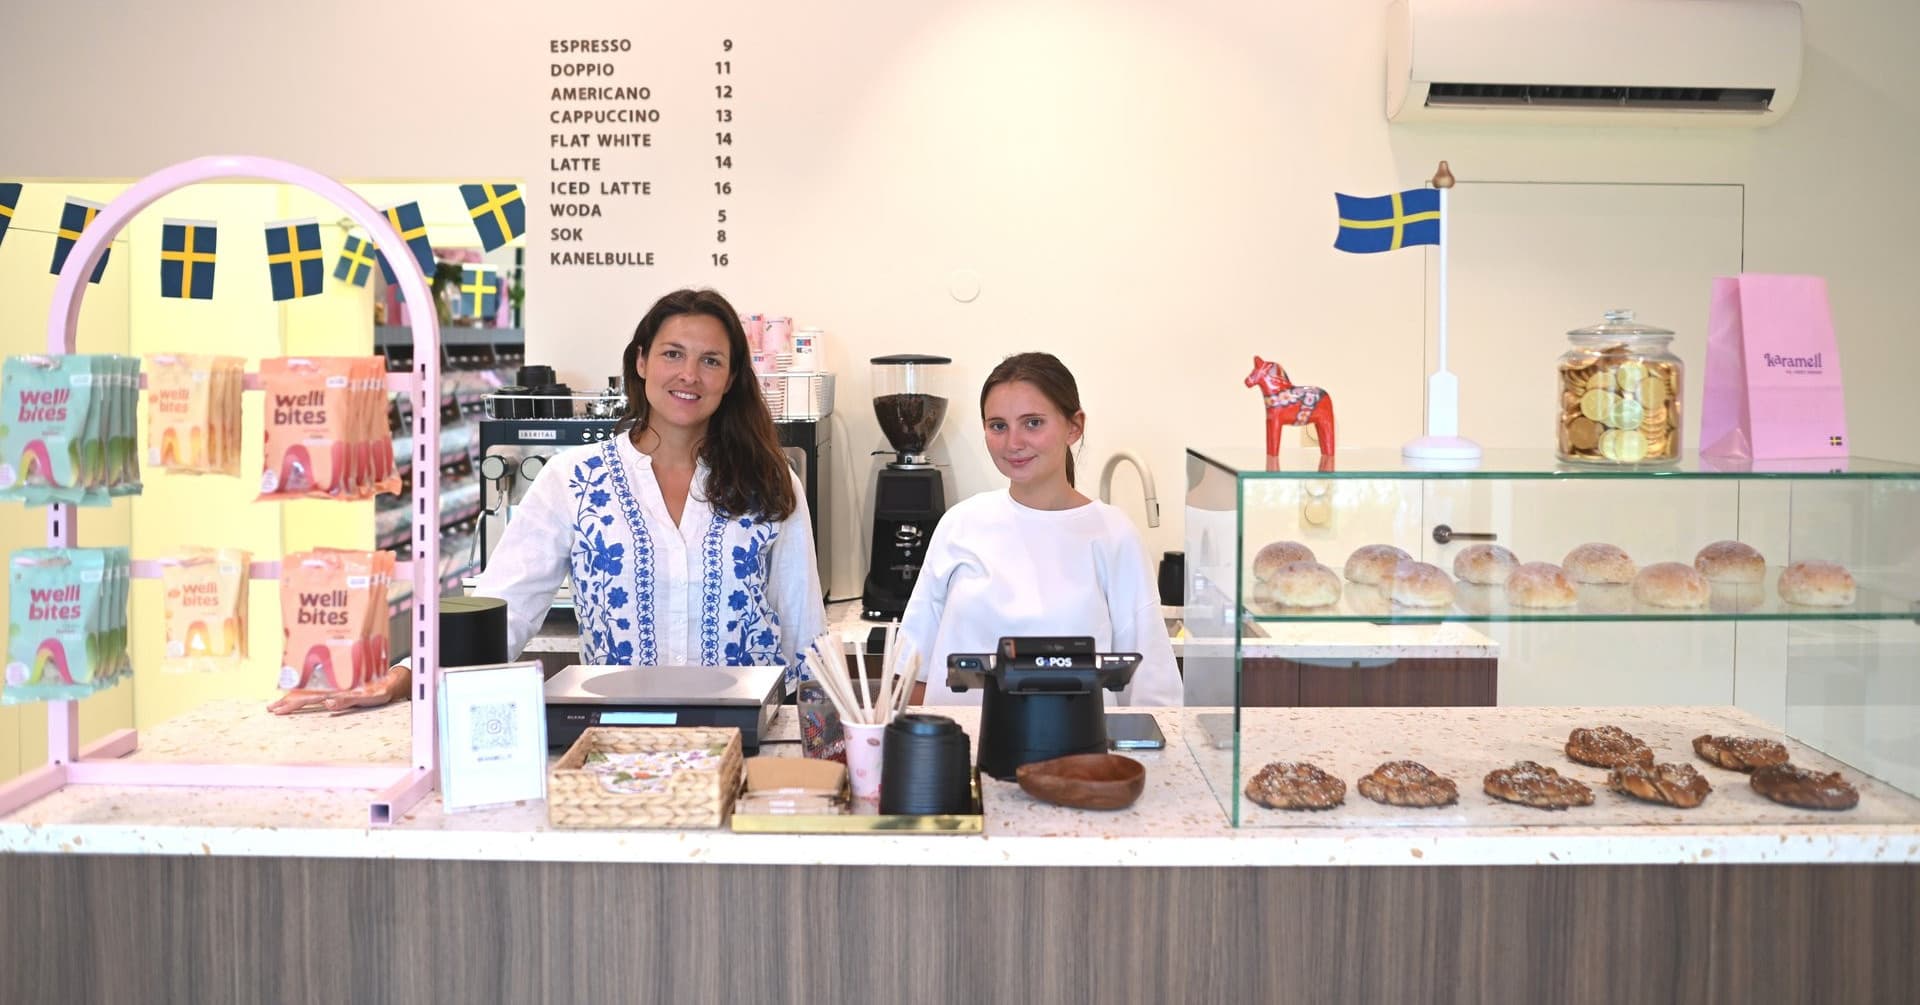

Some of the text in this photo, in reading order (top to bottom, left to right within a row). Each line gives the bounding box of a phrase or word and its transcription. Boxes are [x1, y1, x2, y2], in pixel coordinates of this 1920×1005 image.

[550, 39, 733, 53] ESPRESSO 9
[551, 61, 730, 77] DOPPIO 11
[551, 85, 732, 100] AMERICANO 12
[550, 109, 732, 123] CAPPUCCINO 13
[551, 132, 732, 147] FLAT WHITE 14
[551, 156, 732, 171] LATTE 14
[551, 182, 731, 195] ICED LATTE 16
[550, 204, 726, 223] WODA 5
[551, 228, 726, 242] SOK 8
[551, 252, 728, 266] KANELBULLE 16
[1764, 352, 1822, 368] karamell
[275, 391, 325, 407] welli
[17, 404, 68, 422] bites
[273, 408, 326, 424] bites
[183, 582, 217, 593] welli
[183, 595, 219, 606] bites
[299, 590, 348, 607] welli
[28, 603, 81, 620] bites
[297, 607, 349, 624] bites
